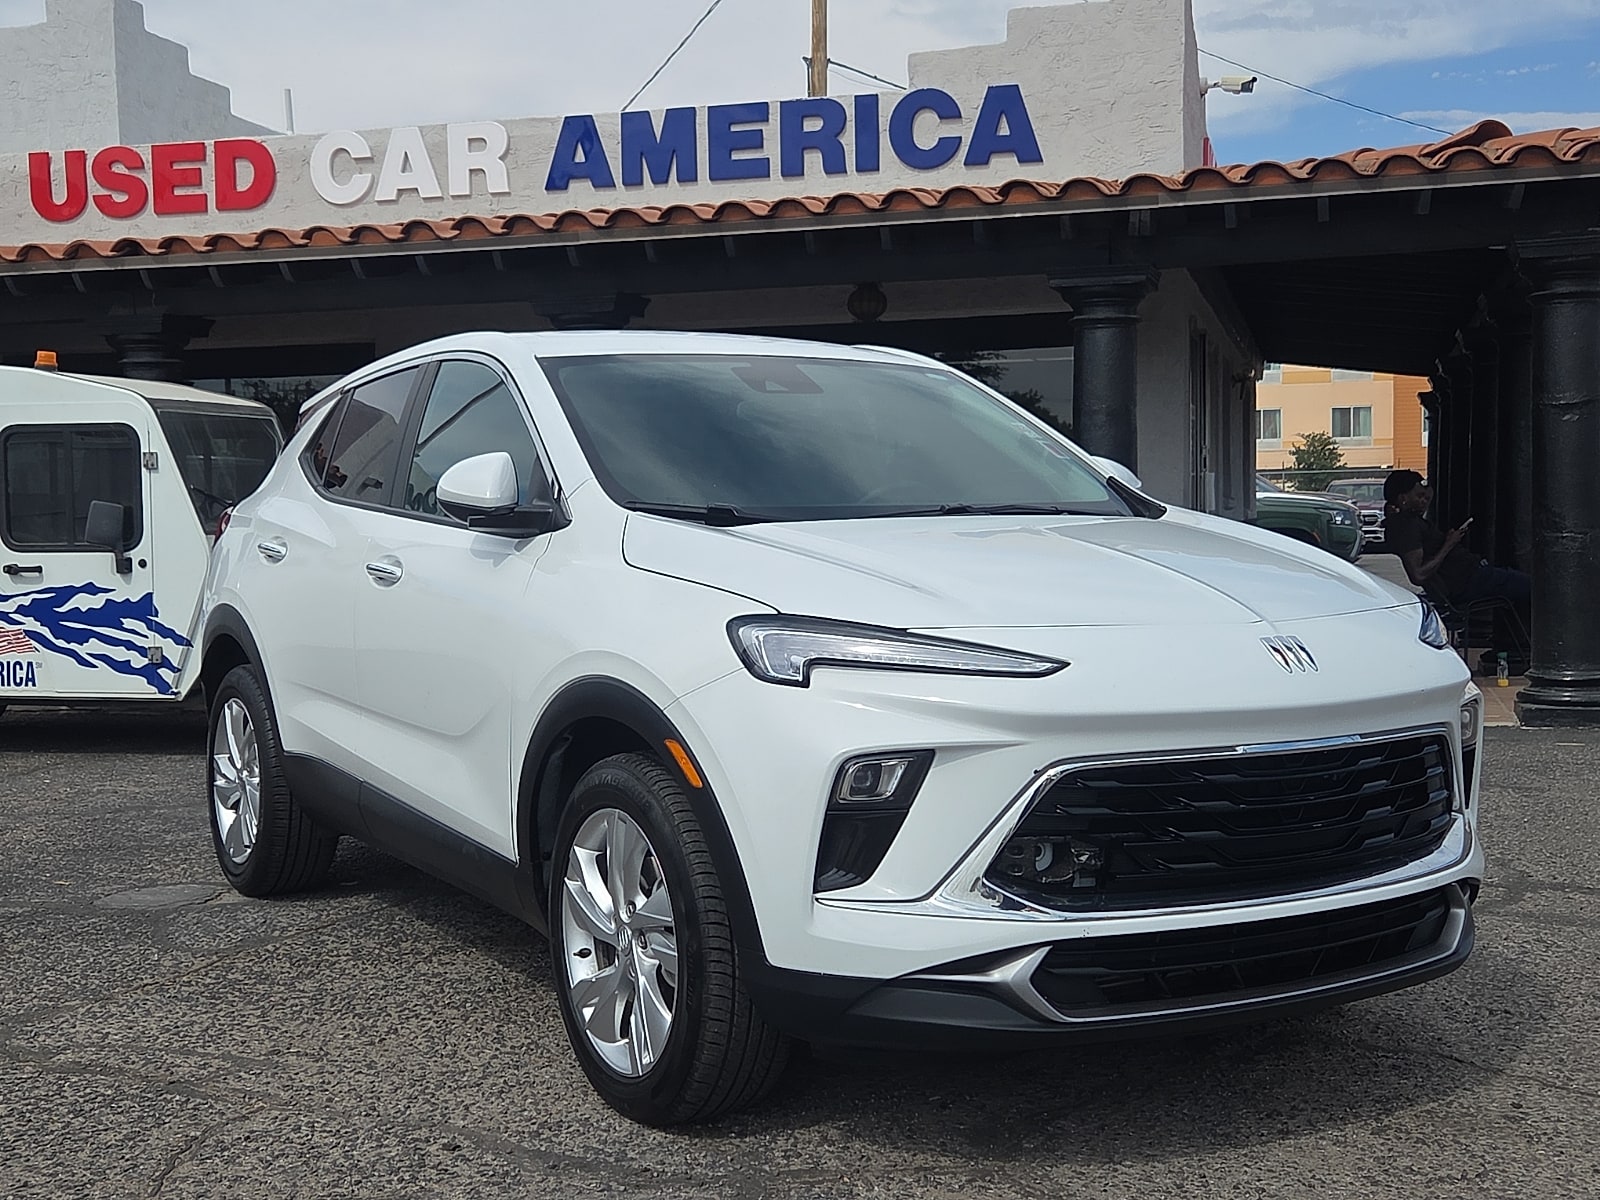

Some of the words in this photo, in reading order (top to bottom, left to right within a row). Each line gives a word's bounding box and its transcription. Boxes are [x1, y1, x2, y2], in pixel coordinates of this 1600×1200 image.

[28, 138, 277, 222] USED
[309, 121, 511, 204] CAR
[545, 84, 1044, 191] AMERICA
